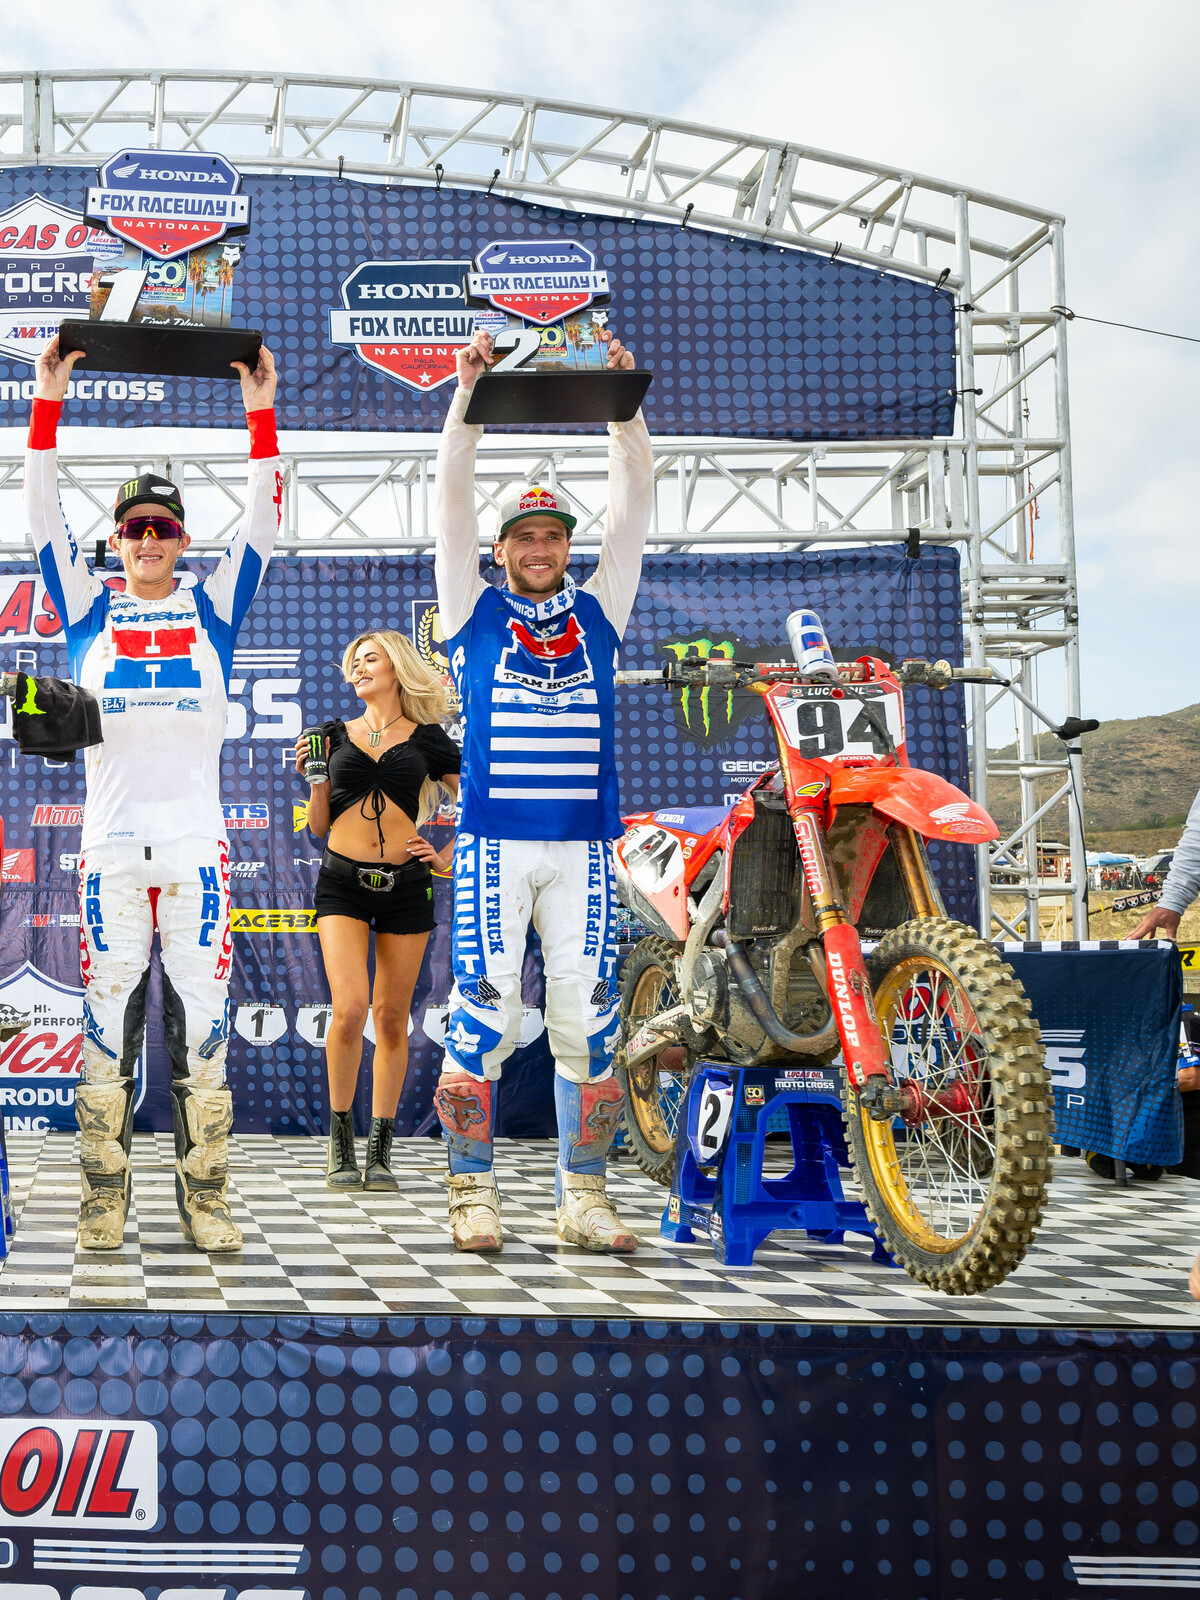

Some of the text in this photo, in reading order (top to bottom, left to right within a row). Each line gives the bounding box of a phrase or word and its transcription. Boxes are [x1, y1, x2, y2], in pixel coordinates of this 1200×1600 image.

[139, 168, 228, 185] HONDA
[99, 194, 133, 212] FOX
[138, 196, 226, 217] RACEWAY
[123, 220, 211, 232] NATIONAL
[8, 263, 65, 271] PRO
[509, 255, 586, 265] HONDA
[148, 260, 181, 285] 50
[480, 278, 511, 290] FOX
[513, 276, 590, 289] RACEWAY
[99, 270, 148, 322] 1
[5, 327, 46, 338] AMA
[350, 317, 476, 337] FOX RACEWA
[375, 347, 459, 356] NATIONA
[492, 329, 540, 372] 2
[519, 500, 557, 511] Red Bull
[504, 672, 589, 689] TEAM HONDA
[797, 701, 893, 760] 94
[655, 813, 685, 824] HONDA
[936, 818, 987, 826] HONDA
[793, 821, 824, 896] SHOWA
[486, 838, 505, 956] UPER TRICK
[86, 873, 109, 951] HRC
[199, 867, 220, 947] HRC
[18, 914, 58, 927] AMA
[584, 893, 601, 957] SUPER
[828, 951, 860, 1048] DUNLOP
[34, 1004, 51, 1013] HI-
[34, 1018, 84, 1026] PERFOR
[746, 1087, 761, 1098] 50
[702, 1094, 721, 1148] 2
